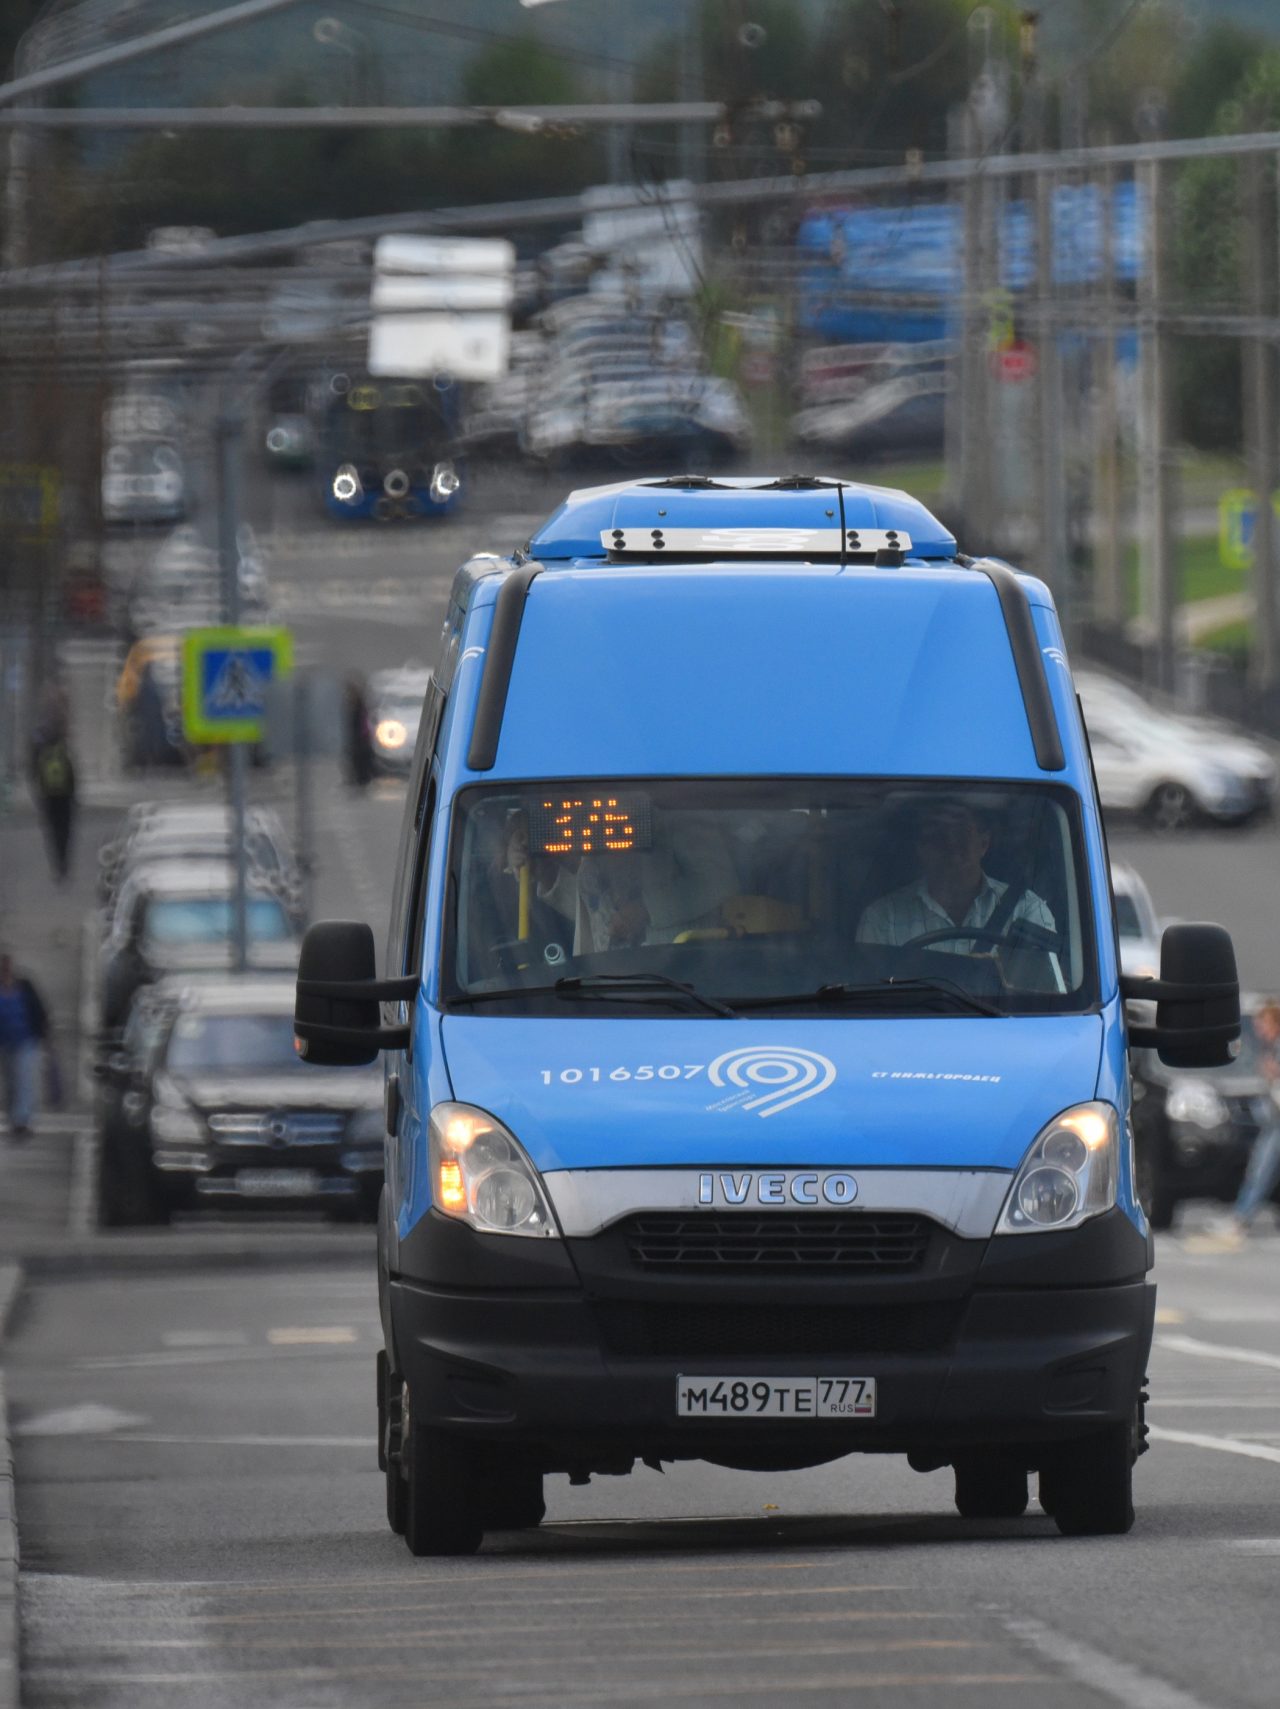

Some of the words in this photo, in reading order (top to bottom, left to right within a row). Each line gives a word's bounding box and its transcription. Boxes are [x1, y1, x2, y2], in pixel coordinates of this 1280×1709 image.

[543, 799, 634, 852] 376
[540, 1065, 705, 1085] 1016507
[699, 1173, 859, 1205] IVECO
[830, 1404, 854, 1413] RUS
